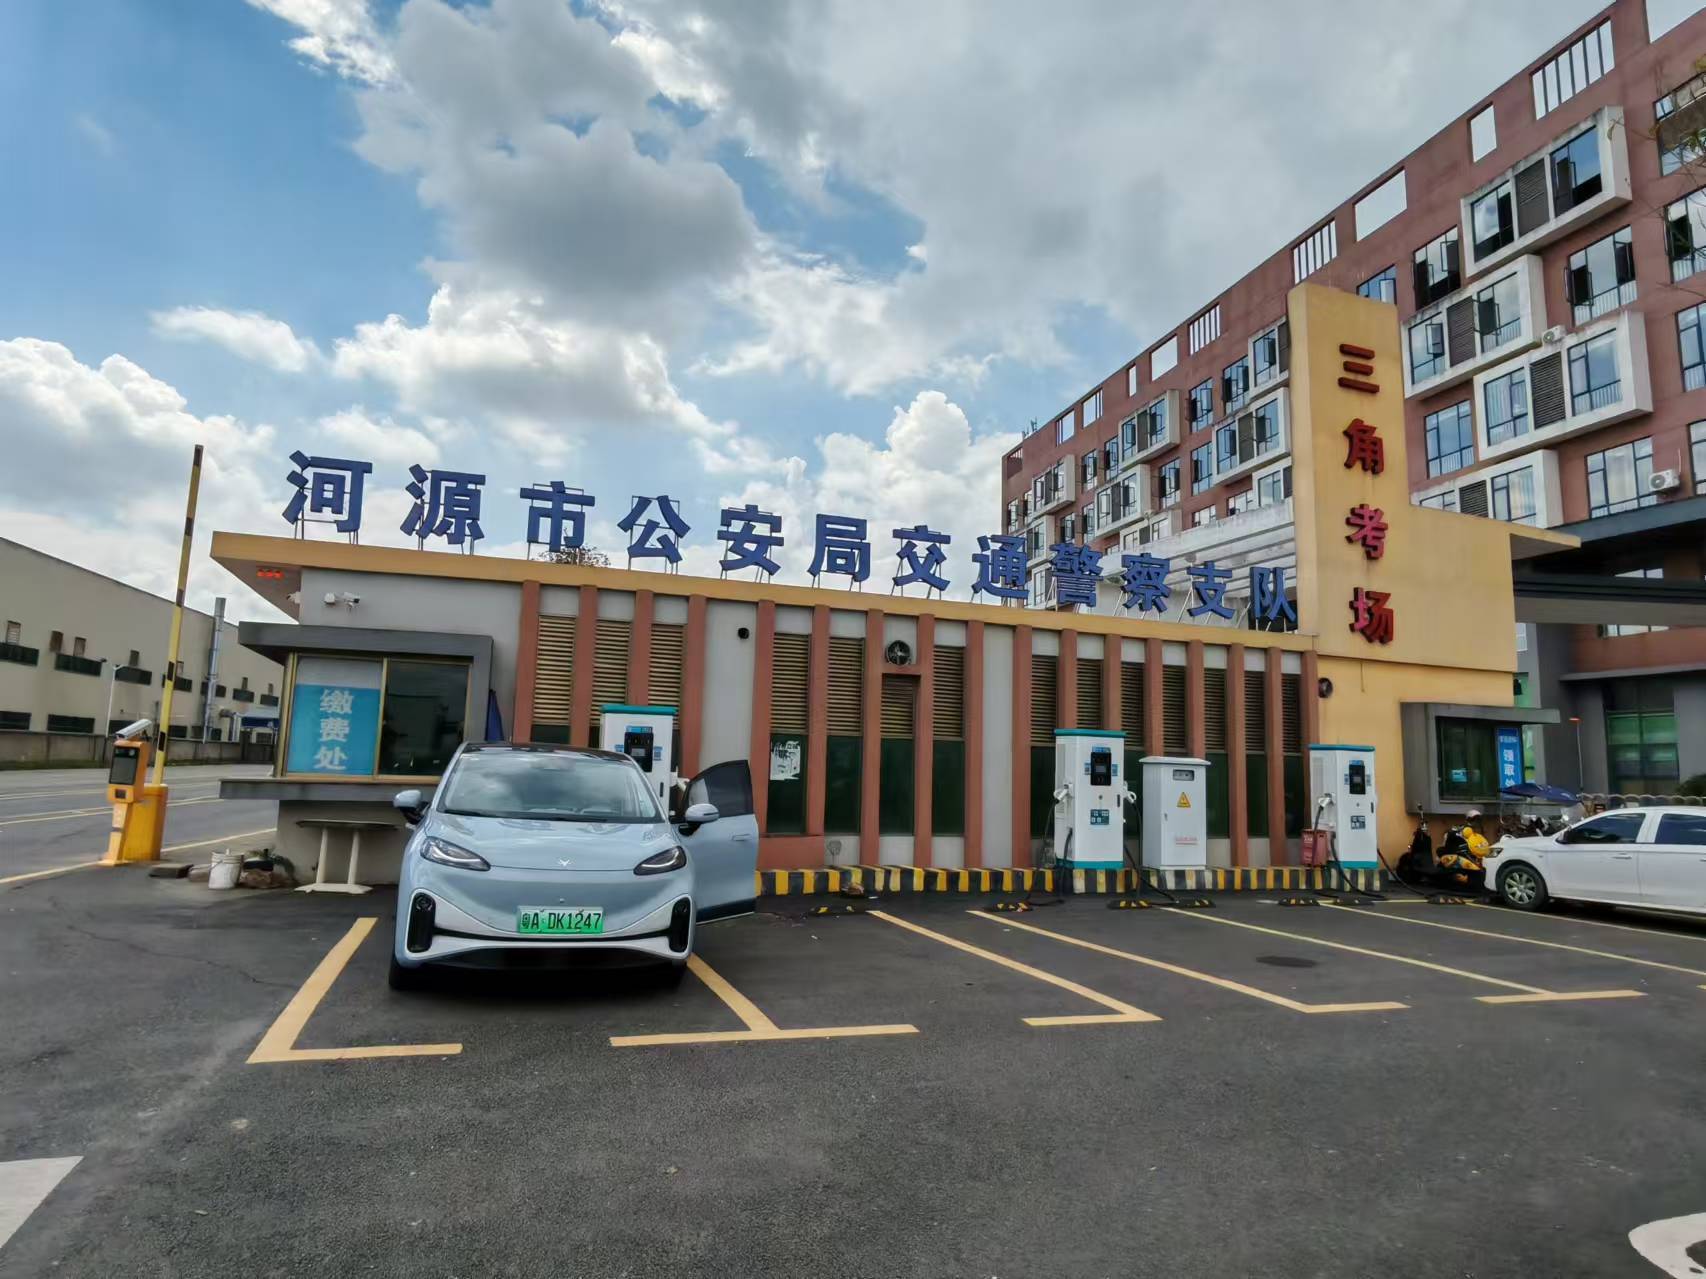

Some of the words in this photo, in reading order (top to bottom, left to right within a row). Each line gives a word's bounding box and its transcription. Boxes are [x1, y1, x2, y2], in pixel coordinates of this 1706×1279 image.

[282, 449, 1298, 625] 河源市公安局交通警察支队
[1337, 343, 1395, 645] 三角考场
[313, 689, 353, 770] 缴费处
